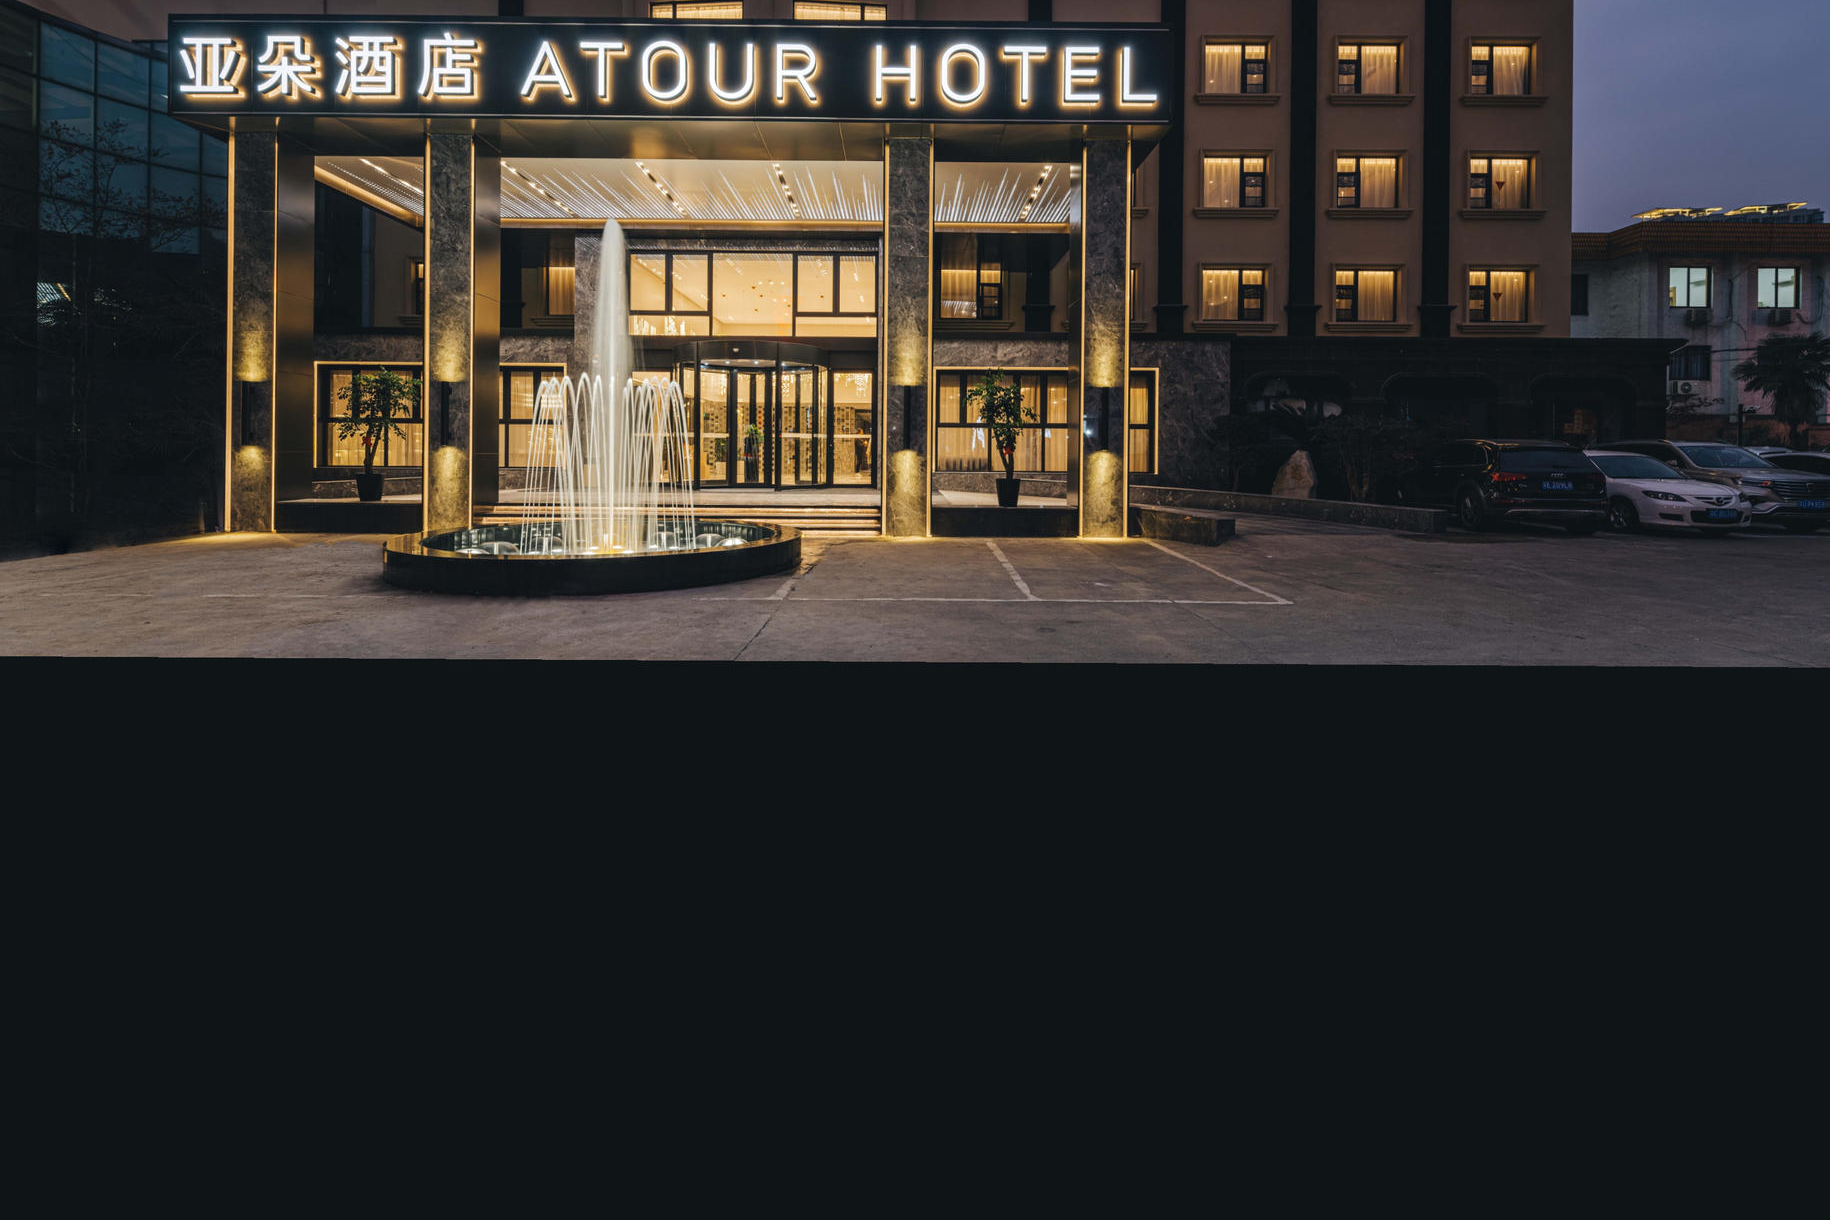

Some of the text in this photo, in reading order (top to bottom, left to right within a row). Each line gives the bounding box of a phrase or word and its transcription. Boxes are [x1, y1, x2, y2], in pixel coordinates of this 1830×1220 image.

[179, 32, 1158, 108] 亚朵酒店 ATOUR HOTEL
